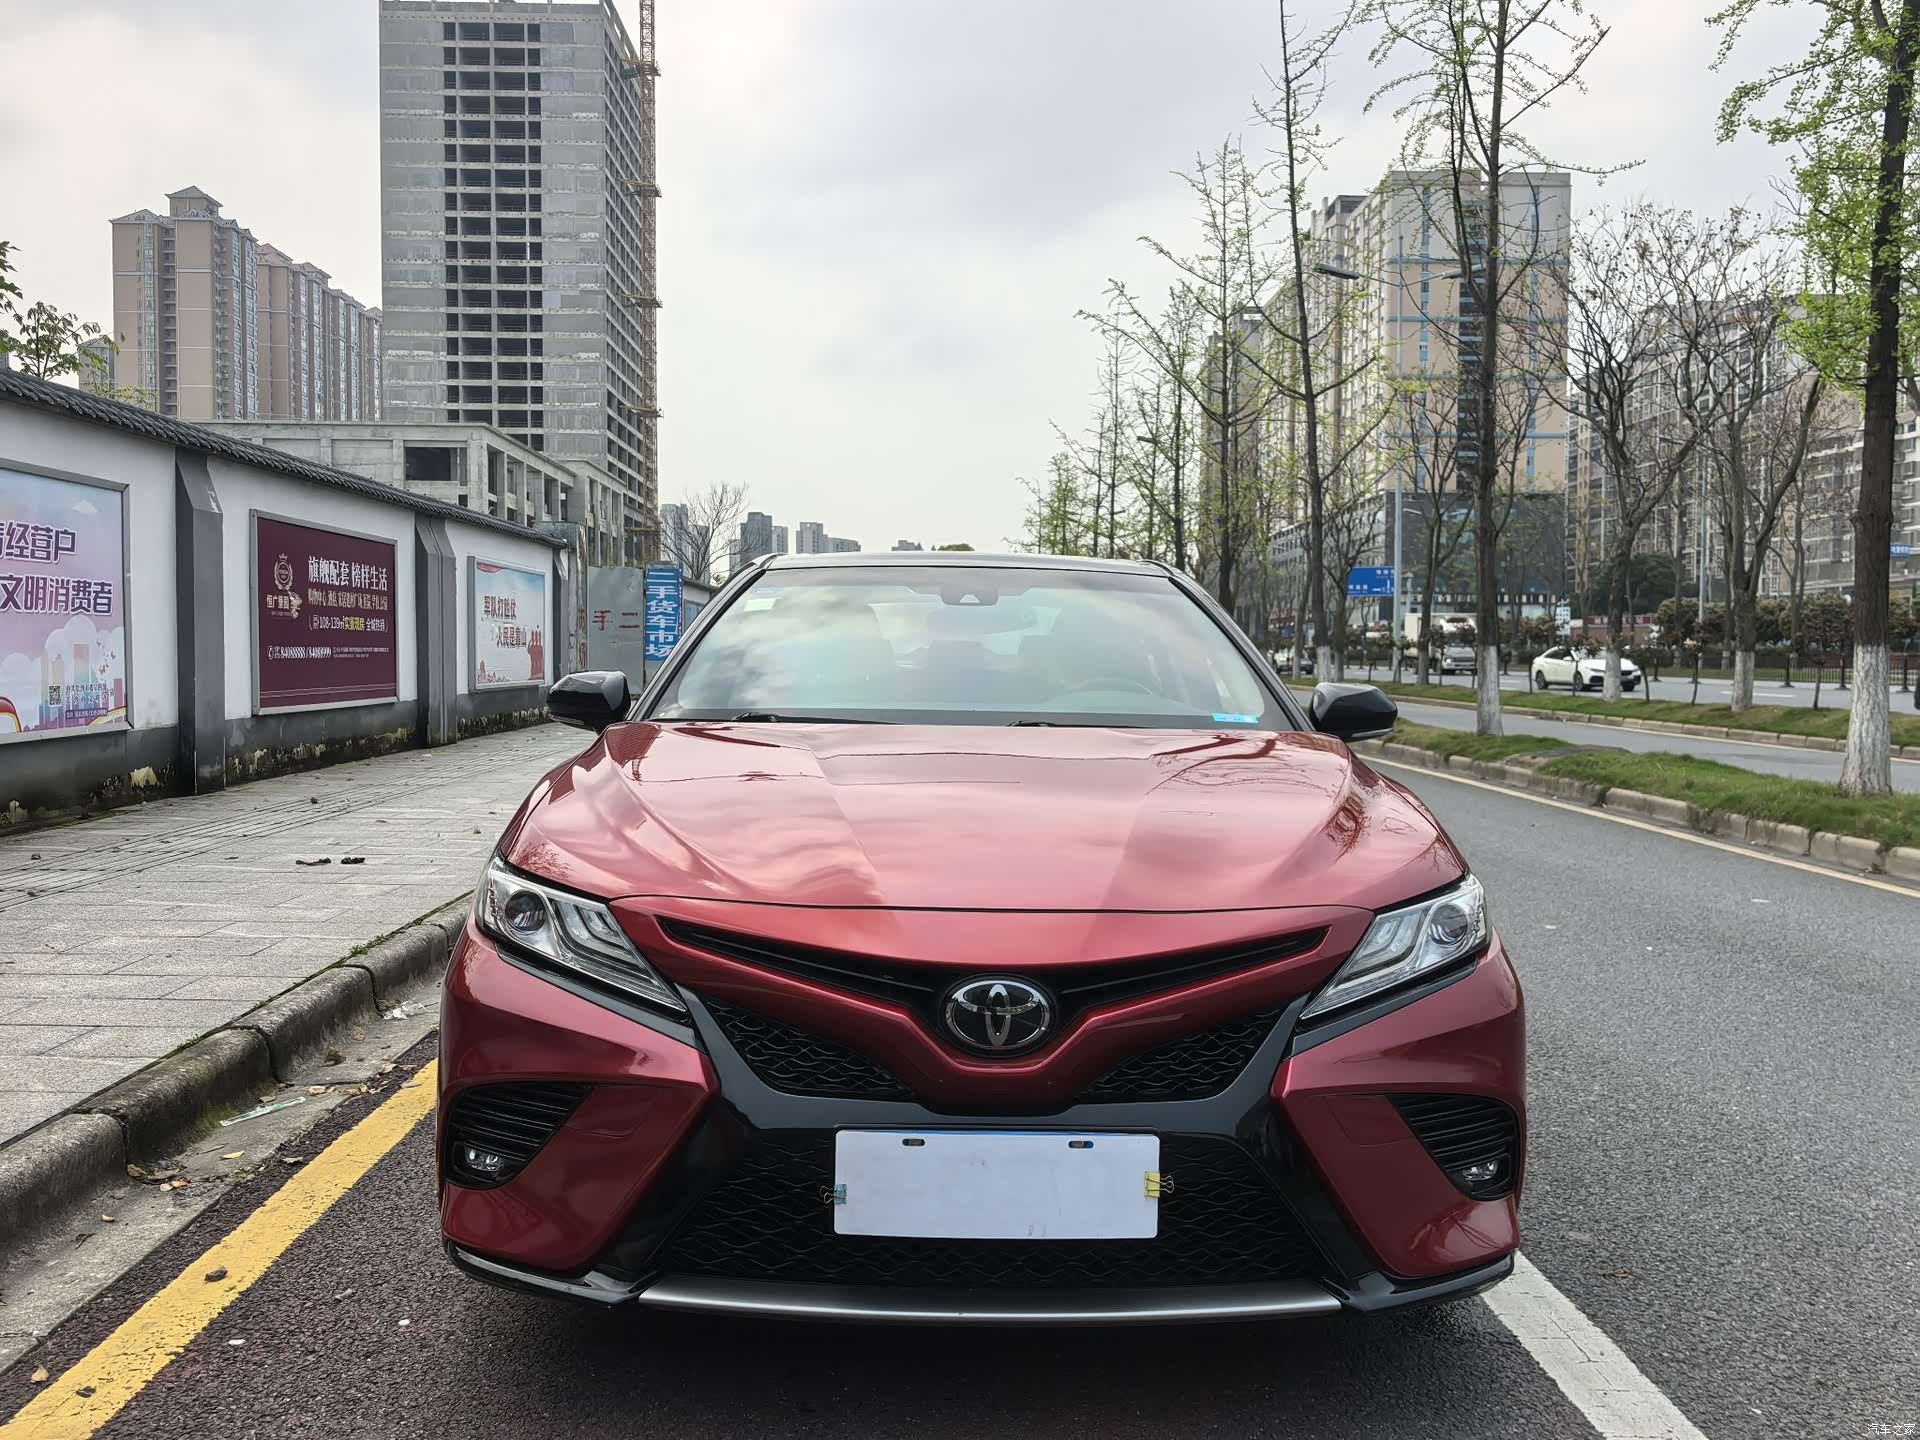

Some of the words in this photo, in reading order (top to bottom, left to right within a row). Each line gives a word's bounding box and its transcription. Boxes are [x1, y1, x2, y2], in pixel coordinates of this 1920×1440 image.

[0, 521, 77, 562] 经营户
[0, 574, 113, 614] 文明消费者
[351, 562, 388, 591] 榜样生活
[645, 571, 678, 657] 二手货车市场
